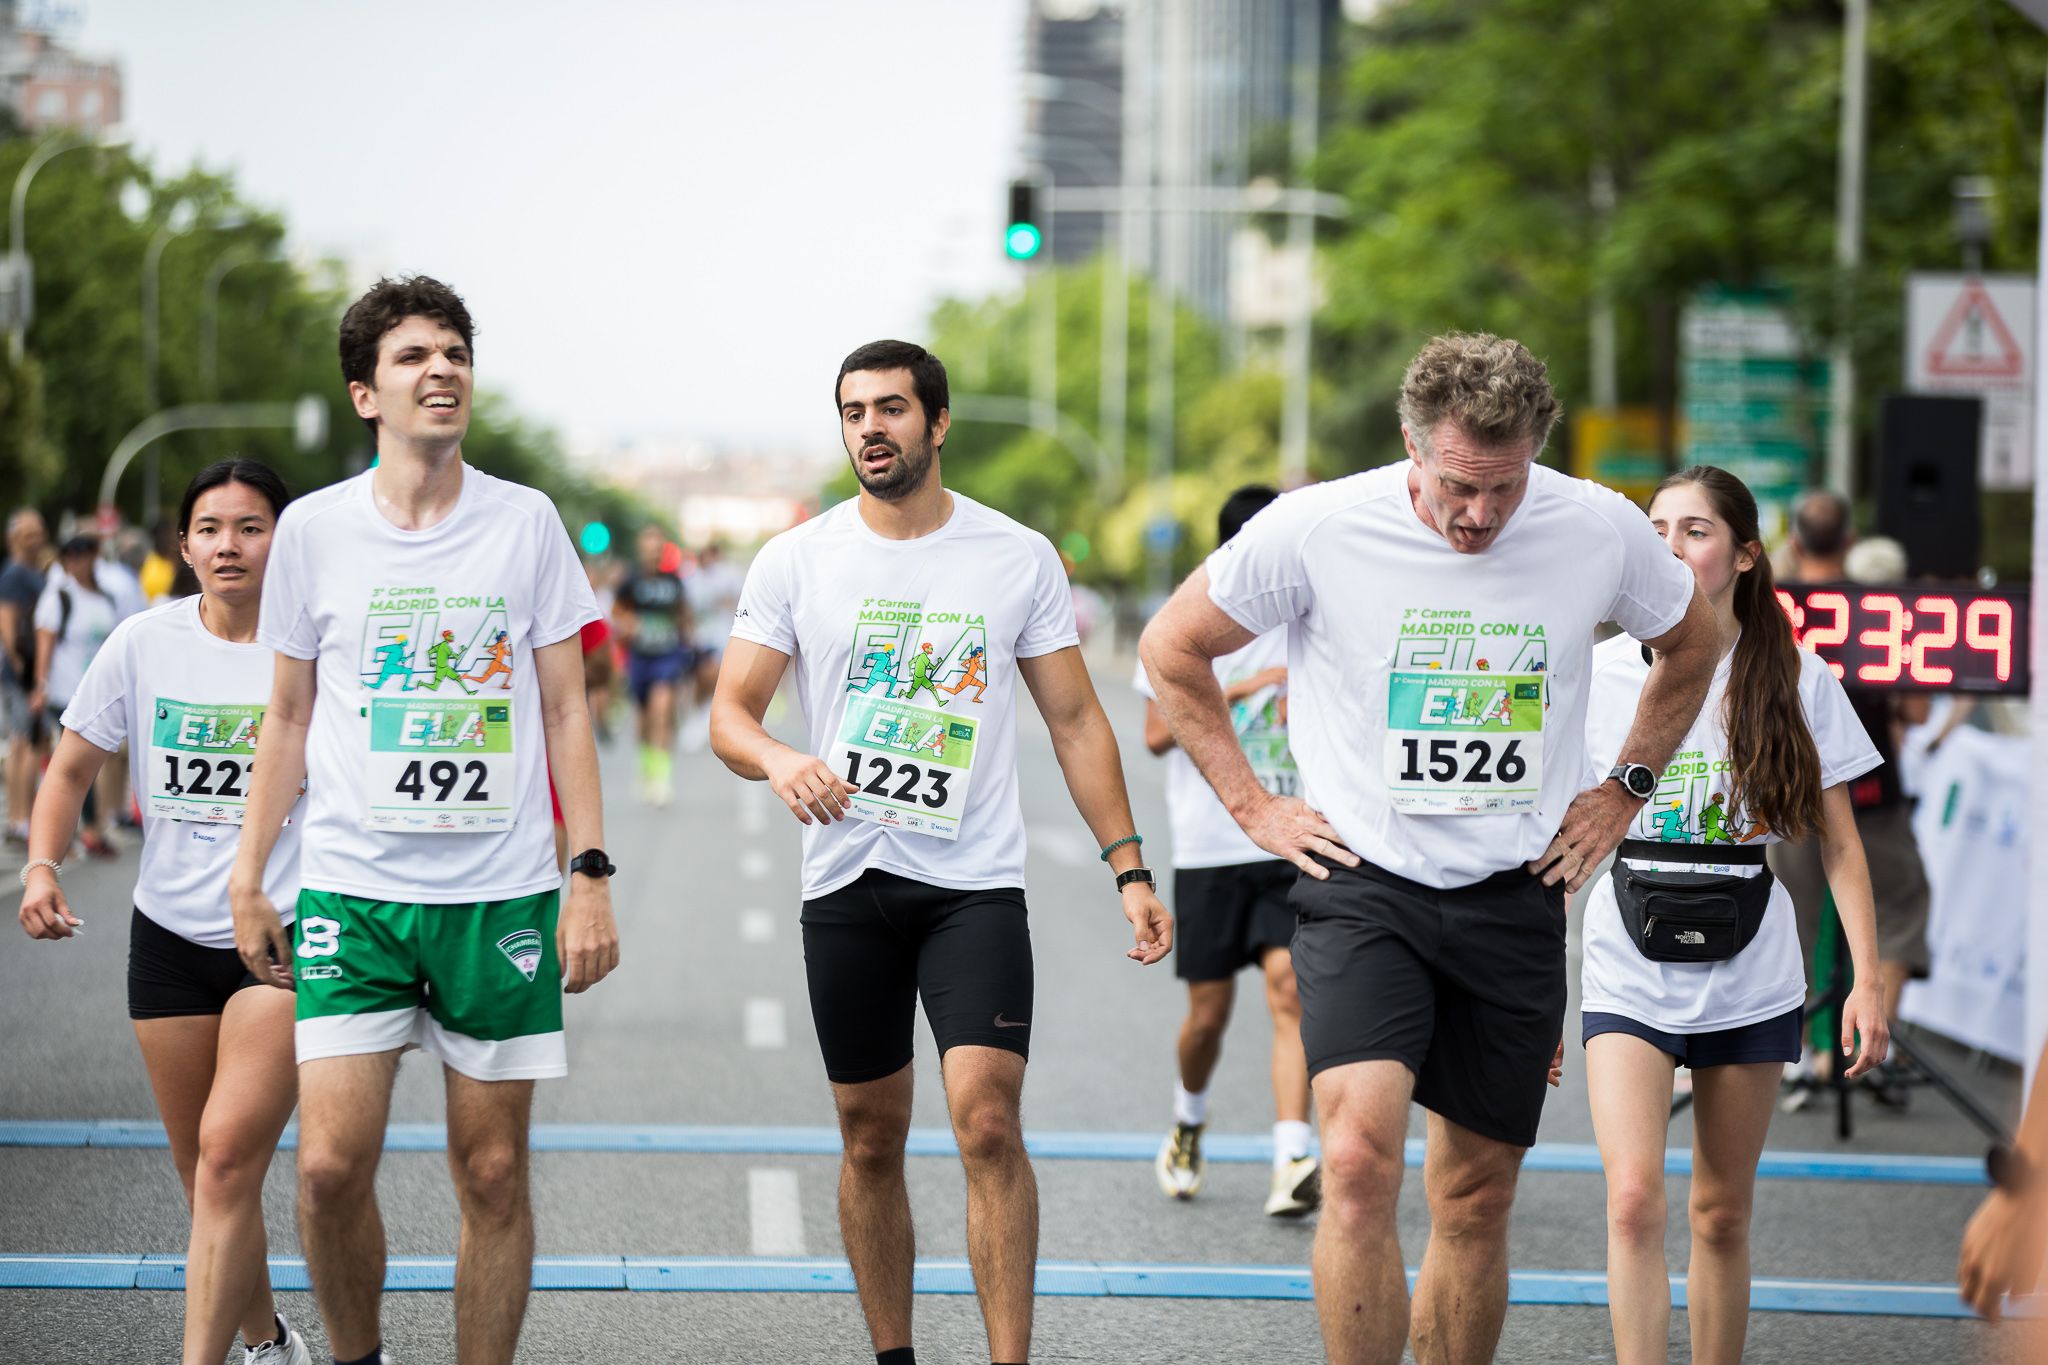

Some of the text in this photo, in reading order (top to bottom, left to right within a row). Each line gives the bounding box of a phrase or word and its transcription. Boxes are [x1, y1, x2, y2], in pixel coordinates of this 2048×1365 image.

[369, 596, 506, 611] MADRID CON LA
[388, 586, 436, 596] Carrera
[877, 599, 921, 609] Carrera
[858, 610, 985, 626] MADRID CON LA
[1401, 622, 1546, 638] MADRID CON LA
[1421, 608, 1472, 619] Carrera
[360, 609, 514, 676] ELA
[847, 622, 988, 686] ELA
[1428, 678, 1468, 687] MADRID
[1470, 678, 1494, 688] CON
[1494, 679, 1507, 688] LA
[877, 703, 912, 717] MADRID
[912, 711, 932, 721] CON
[932, 714, 944, 724] LA
[1418, 687, 1512, 727] ELA
[176, 714, 258, 750] ELA
[398, 711, 487, 747] ELA
[863, 710, 945, 758] ELA
[165, 754, 254, 798] 122
[1400, 738, 1527, 784] 1526
[395, 759, 489, 802] 492
[846, 750, 952, 809] 1223
